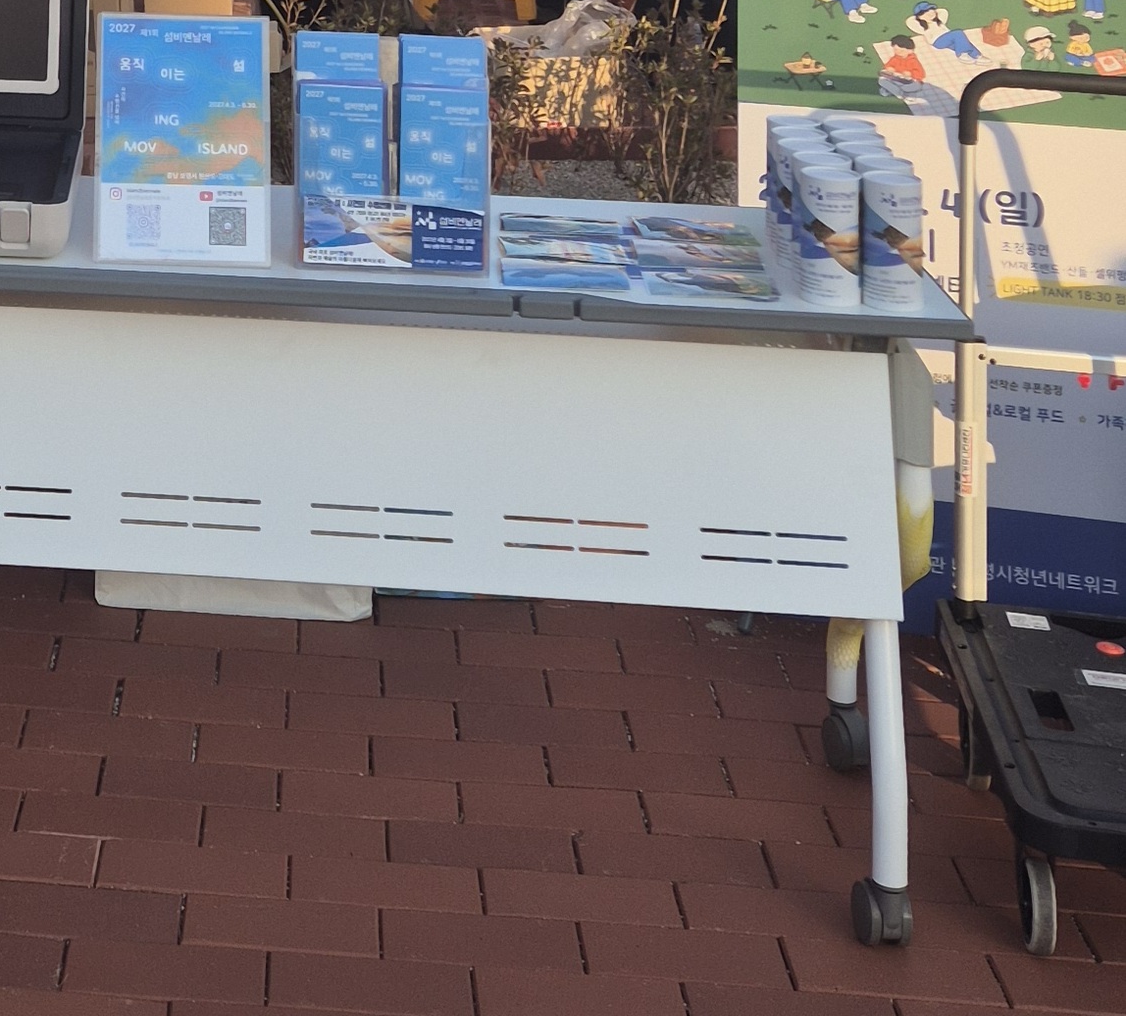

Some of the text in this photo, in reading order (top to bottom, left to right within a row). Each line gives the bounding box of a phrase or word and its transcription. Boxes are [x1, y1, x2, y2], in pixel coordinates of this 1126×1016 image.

[109, 23, 136, 33] 2027
[119, 57, 145, 71] 움직
[160, 68, 186, 81] 이는
[154, 114, 180, 126] ING
[124, 141, 157, 153] MOV
[197, 143, 248, 156] ISLAND
[405, 174, 433, 185] MOV
[1042, 287, 1073, 299] TANK
[1077, 290, 1112, 303] 18:30
[1036, 408, 1065, 424] 푸드
[952, 558, 1119, 595] 시청년네트워크
